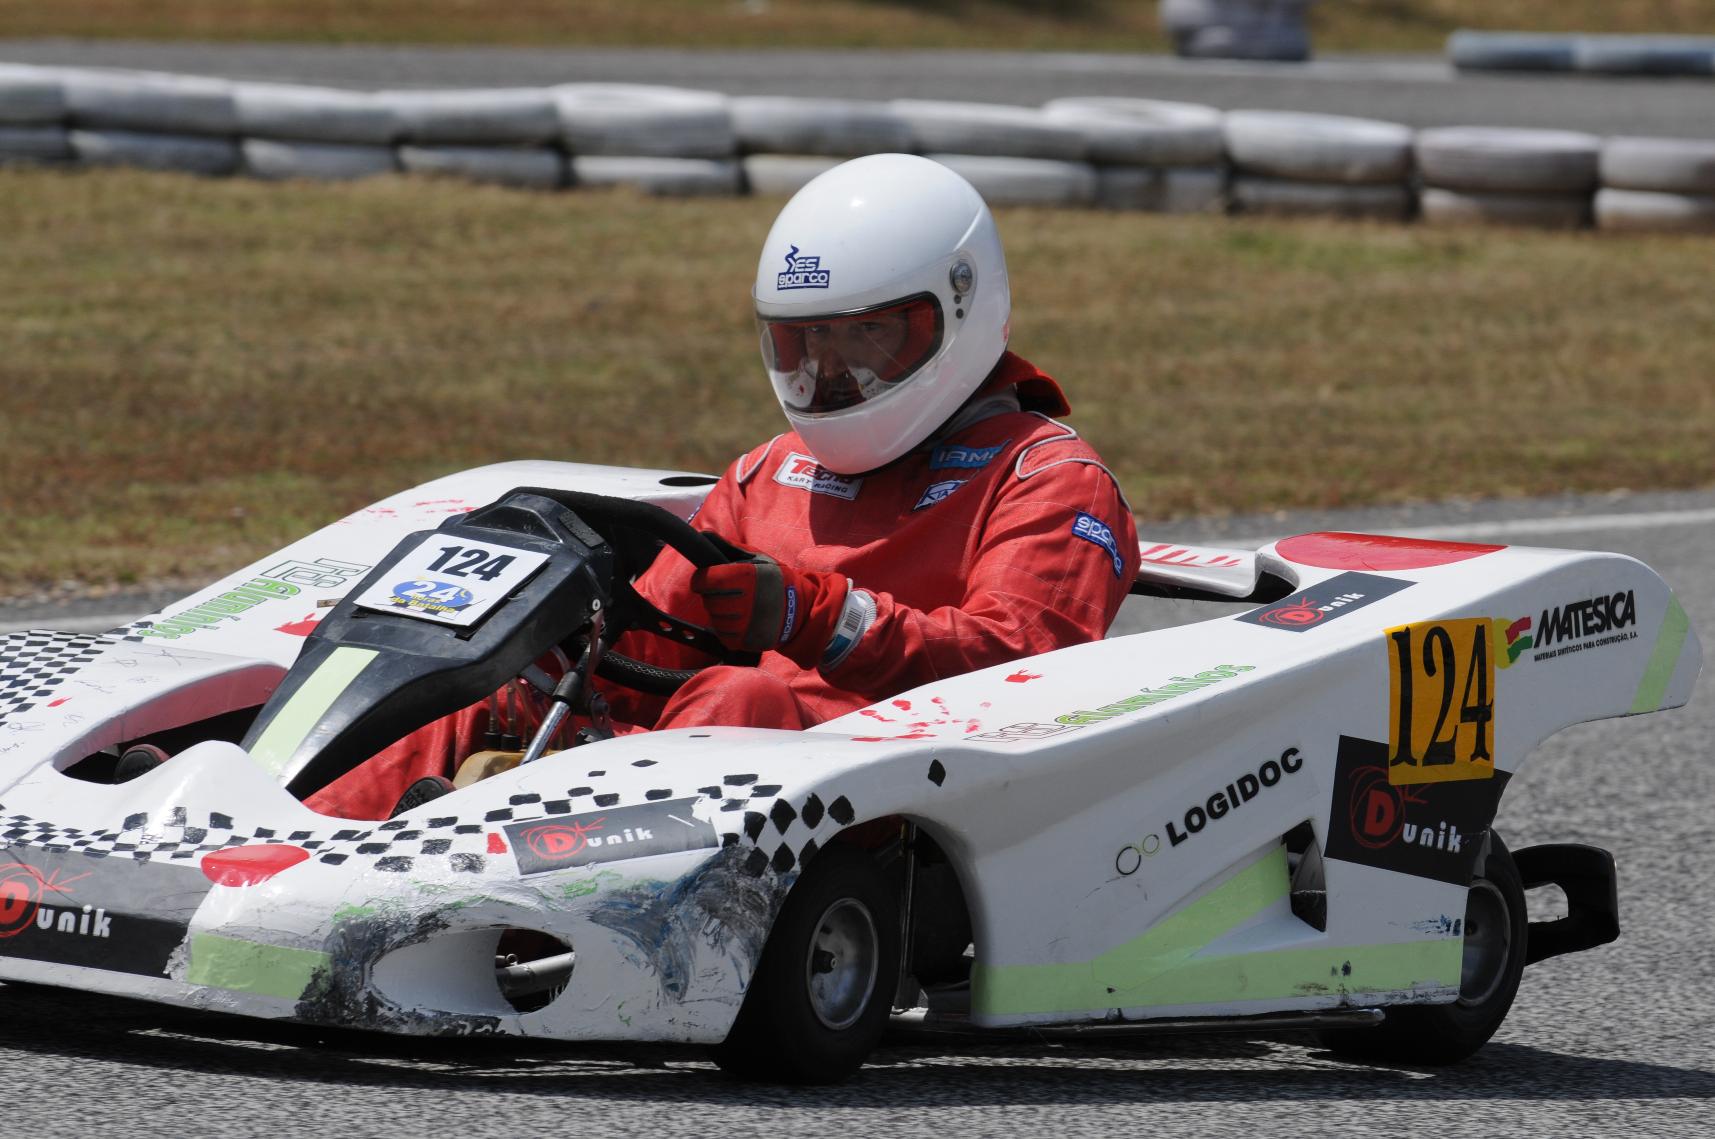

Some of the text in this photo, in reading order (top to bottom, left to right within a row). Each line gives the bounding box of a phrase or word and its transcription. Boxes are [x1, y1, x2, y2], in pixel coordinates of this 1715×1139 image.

[778, 272, 828, 288] sparco
[939, 450, 993, 462] IAM
[814, 482, 848, 494] RACING
[427, 546, 518, 582] 124
[402, 580, 463, 602] 24
[1533, 589, 1636, 649] MATESICA
[1389, 624, 1494, 767] 124
[1165, 747, 1303, 847] LOGIDOC
